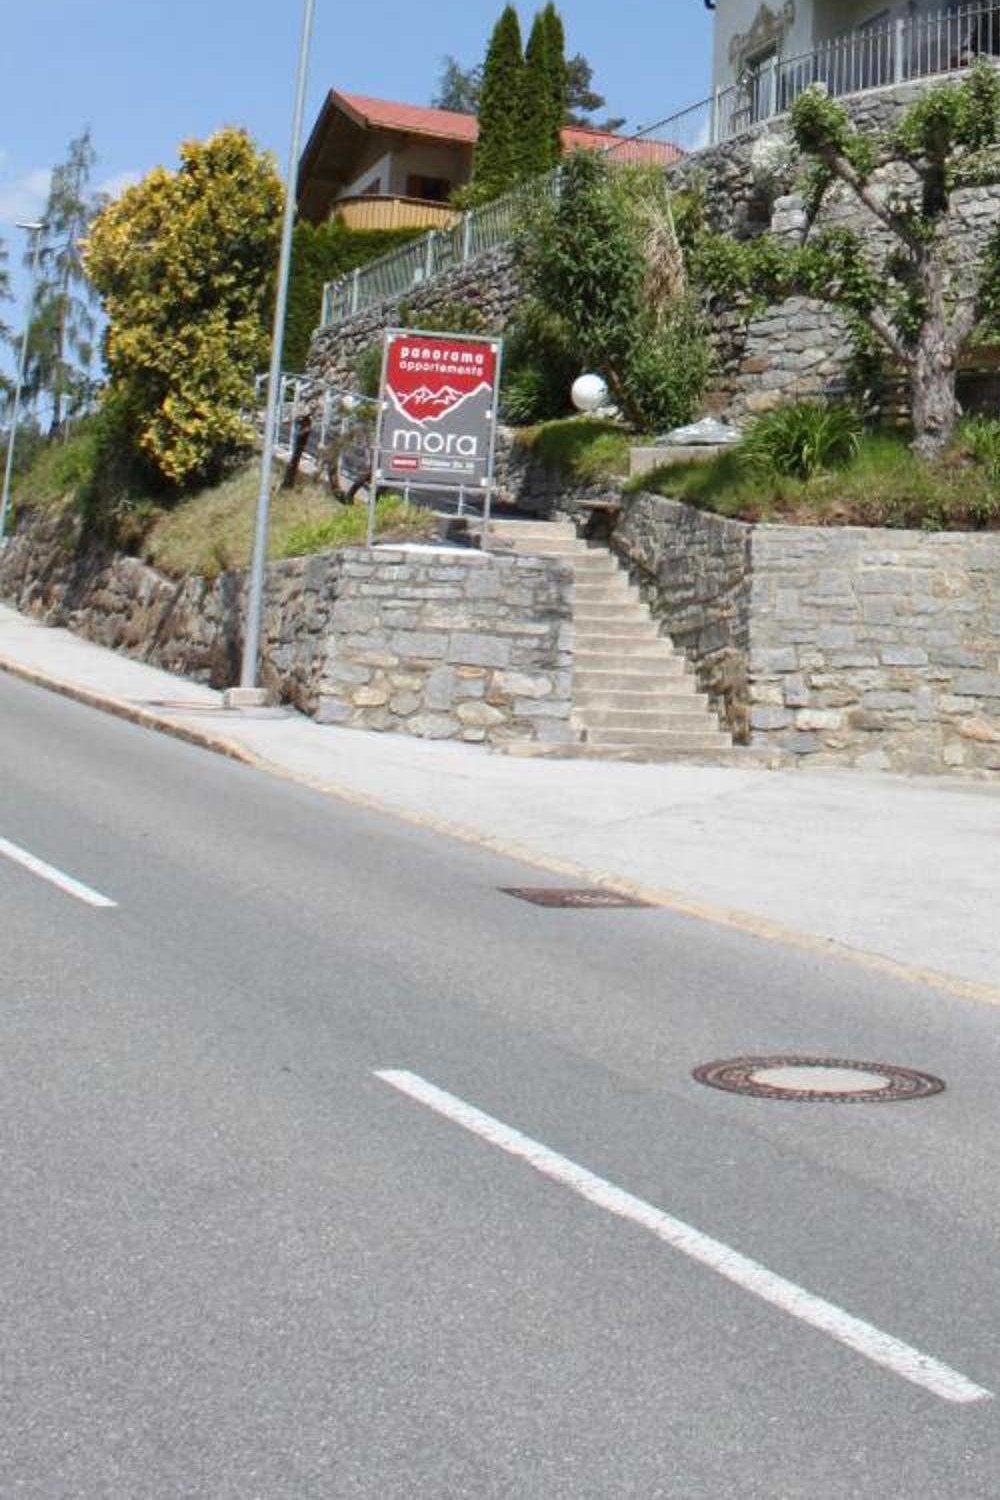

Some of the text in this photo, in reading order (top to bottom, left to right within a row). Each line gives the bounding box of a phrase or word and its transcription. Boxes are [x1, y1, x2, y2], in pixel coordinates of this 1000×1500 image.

[400, 346, 484, 365] panorama
[399, 361, 484, 377] appartements
[393, 429, 477, 456] mora
